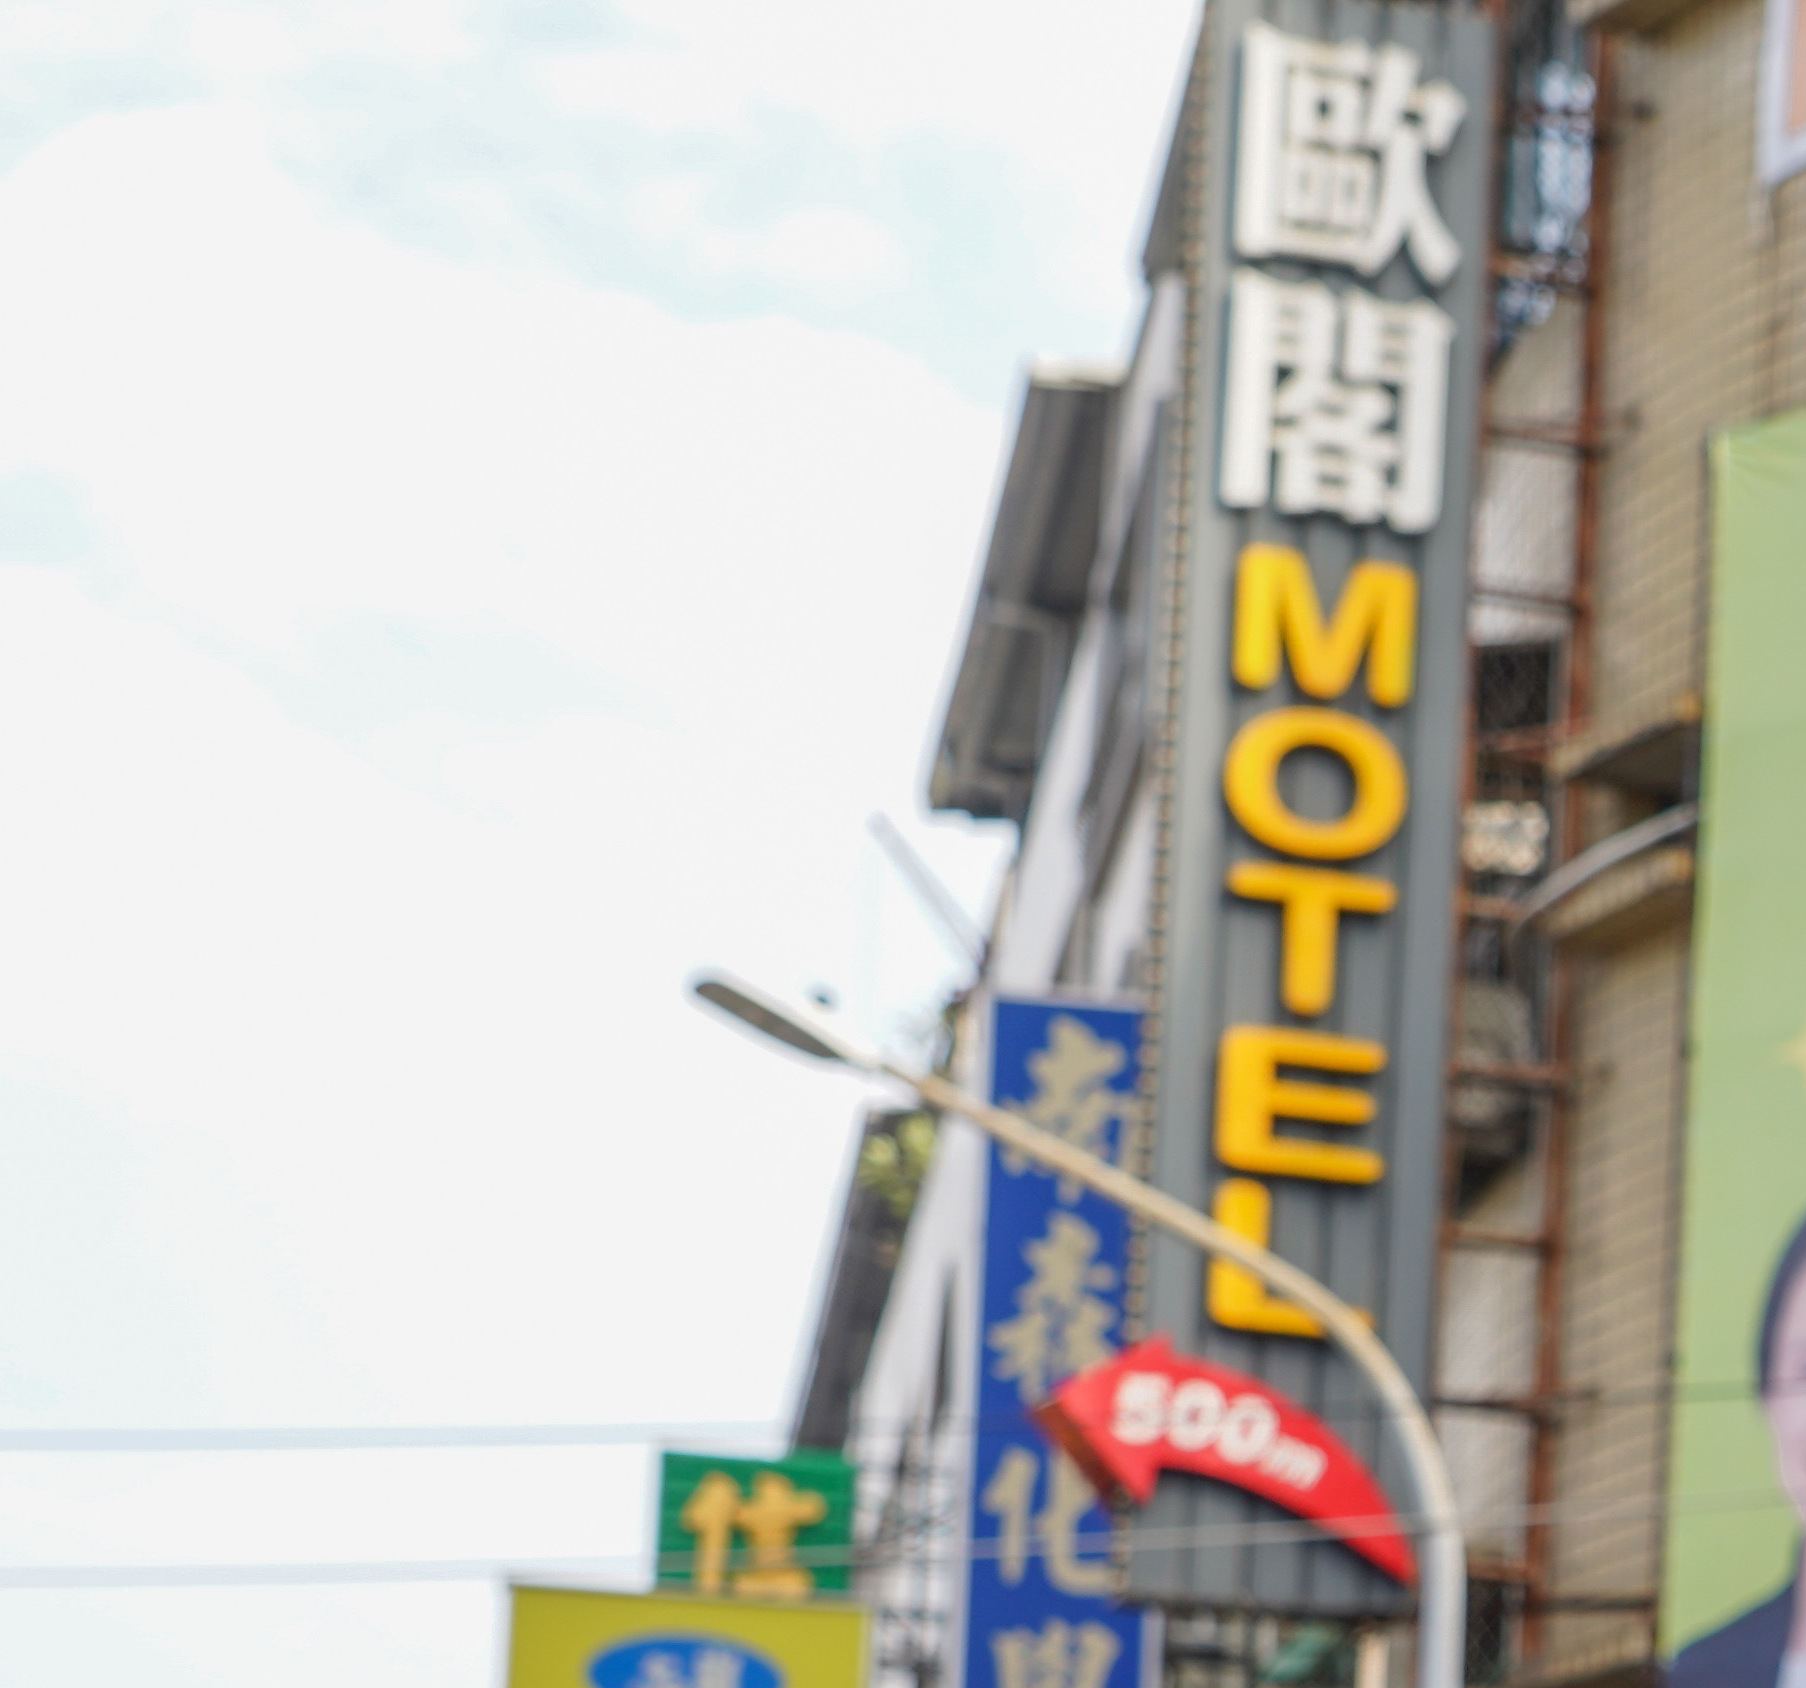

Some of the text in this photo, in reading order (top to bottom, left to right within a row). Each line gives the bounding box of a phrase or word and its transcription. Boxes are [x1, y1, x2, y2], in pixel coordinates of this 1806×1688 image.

[1220, 18, 1467, 535] 歐閣
[1209, 542, 1420, 1338] MOTEL
[1109, 1372, 1329, 1494] 500m
